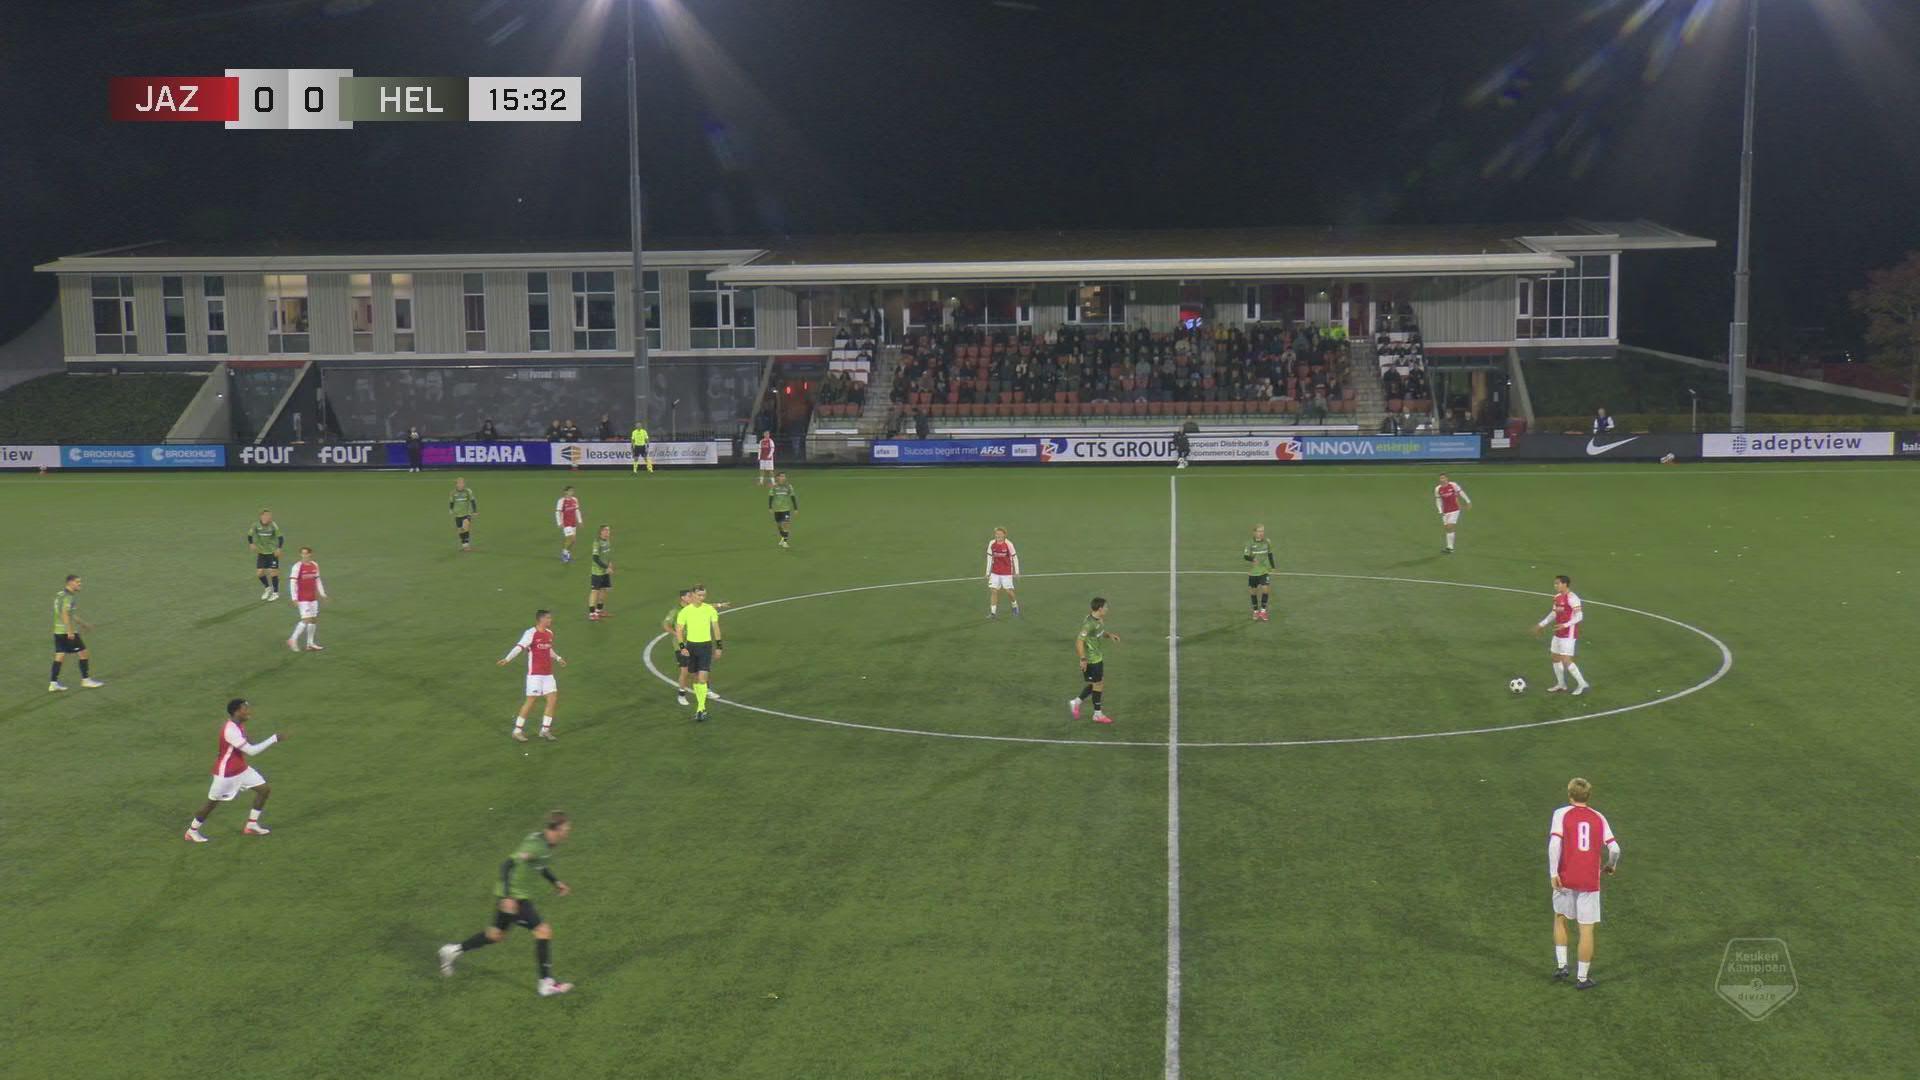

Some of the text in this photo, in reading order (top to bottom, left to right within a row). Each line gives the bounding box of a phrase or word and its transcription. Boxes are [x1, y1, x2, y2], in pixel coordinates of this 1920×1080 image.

[979, 446, 1007, 455] AFAS
[1073, 441, 1178, 458] CTS GROUP
[1306, 441, 1375, 455] INNOVA
[1751, 434, 1862, 453] adeptview
[0, 447, 33, 461] iew
[239, 446, 294, 464] four
[317, 445, 372, 464] four
[455, 445, 527, 463] LEBARA
[586, 448, 633, 459] leasewe
[1577, 821, 1591, 852] 8
